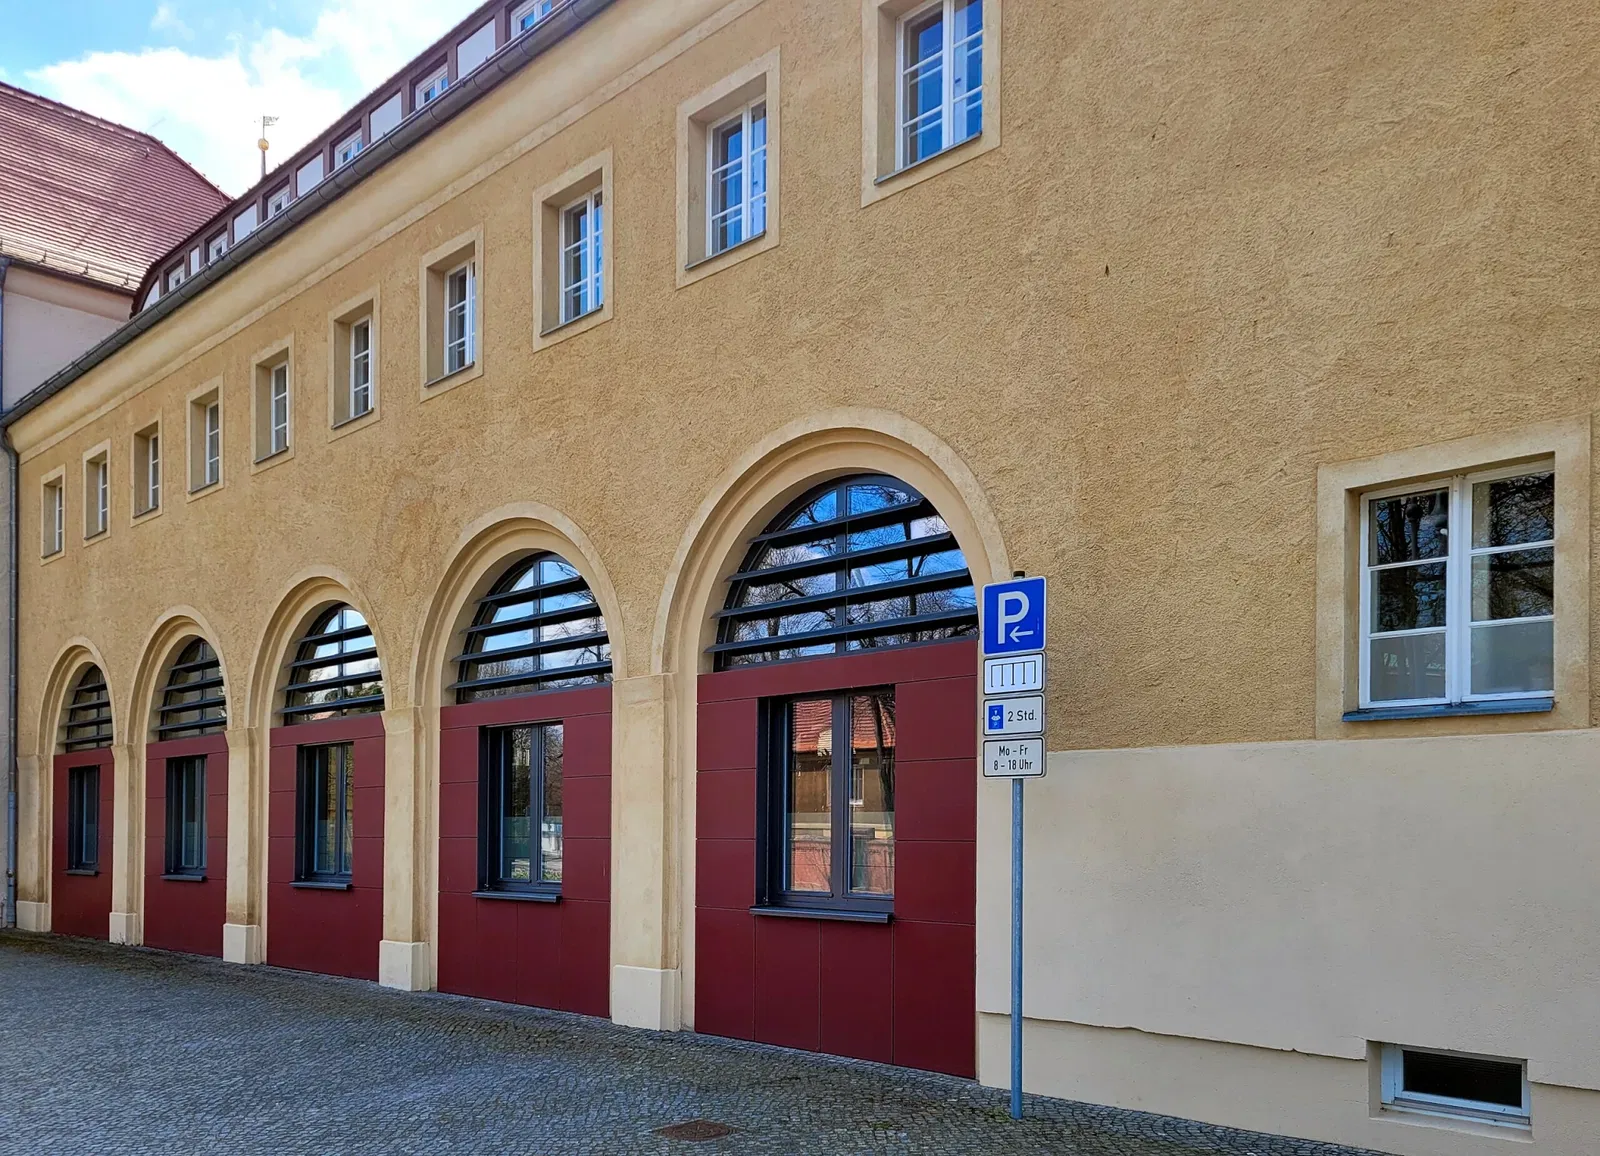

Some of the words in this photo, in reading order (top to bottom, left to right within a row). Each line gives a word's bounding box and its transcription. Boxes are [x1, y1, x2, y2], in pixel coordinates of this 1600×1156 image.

[998, 591, 1029, 644] P
[1008, 710, 1014, 722] 2
[1016, 709, 1037, 721] Std.
[998, 746, 1010, 756] Mo
[1020, 744, 1028, 756] Fr
[994, 760, 998, 770] 8
[1008, 760, 1016, 770] 18
[1019, 758, 1033, 770] Uhr
